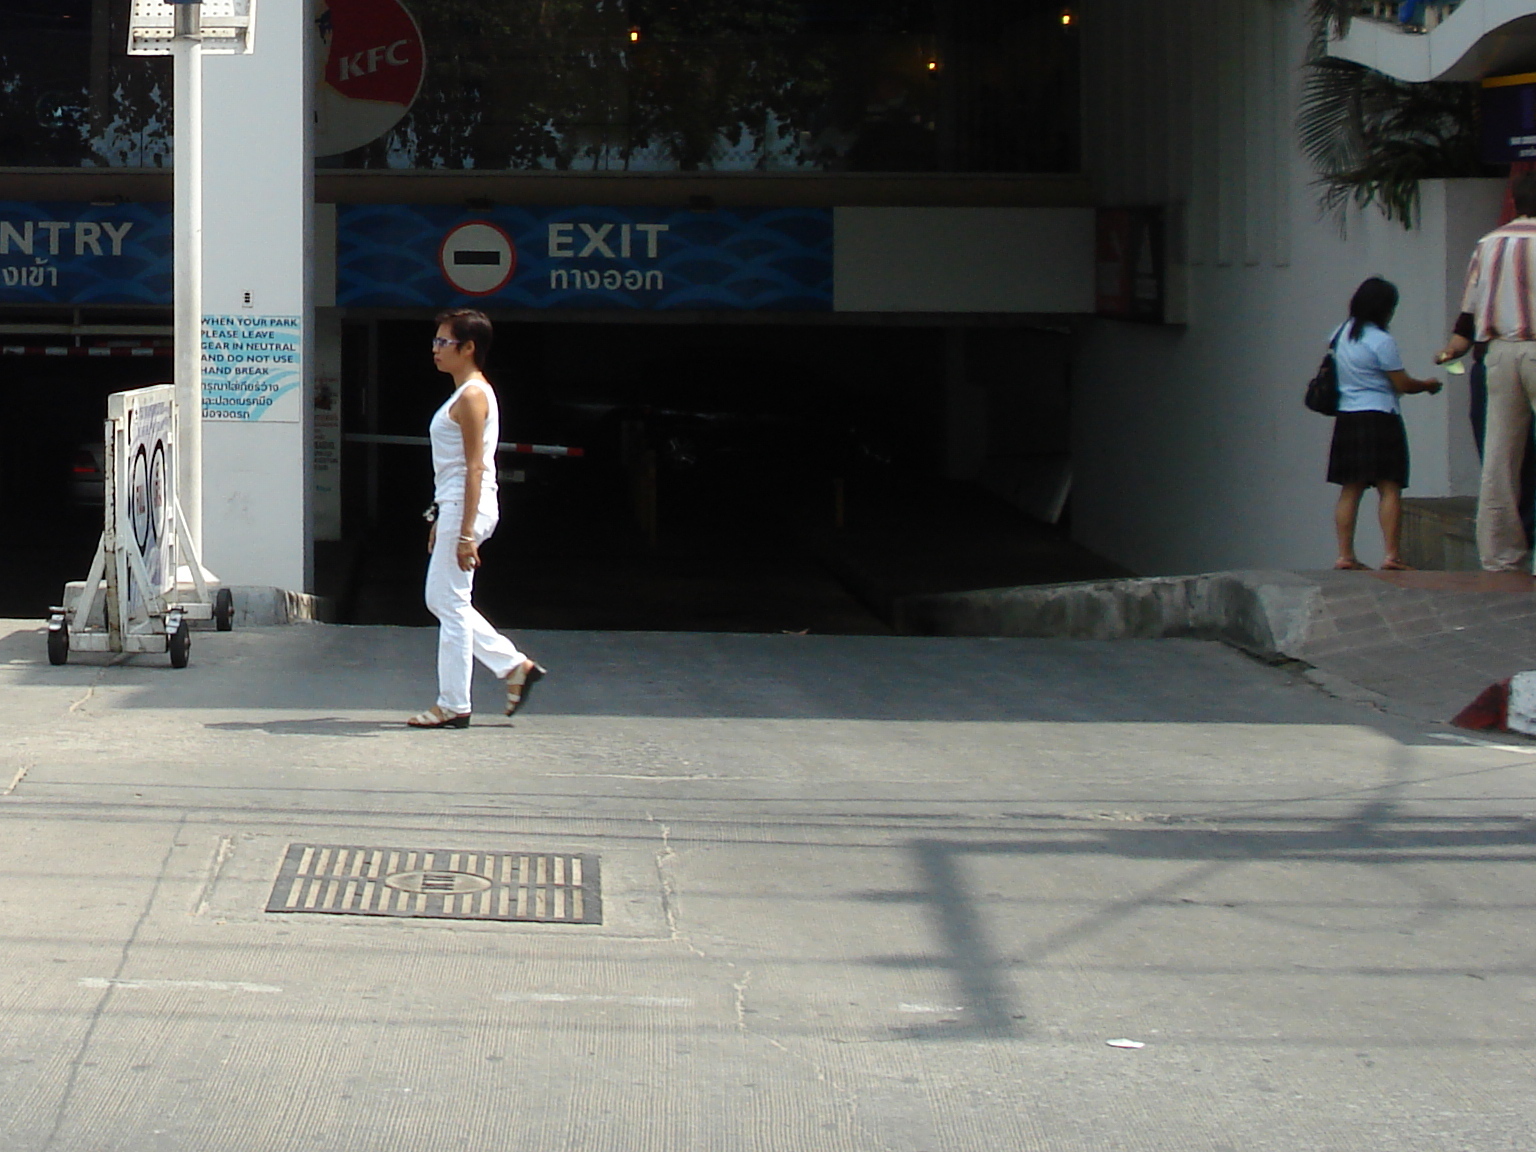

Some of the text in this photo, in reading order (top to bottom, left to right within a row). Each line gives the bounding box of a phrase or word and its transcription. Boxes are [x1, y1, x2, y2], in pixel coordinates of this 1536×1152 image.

[339, 38, 410, 82] KFC
[548, 223, 669, 258] EXIT
[550, 269, 664, 291] ทางออก
[201, 317, 298, 327] WHEN YOUR PARK
[242, 330, 275, 339] LEAVE
[201, 342, 297, 352] GEAR IN NEUTRAL
[201, 354, 294, 364] AND DO NOT USE
[234, 367, 269, 376] BREAK
